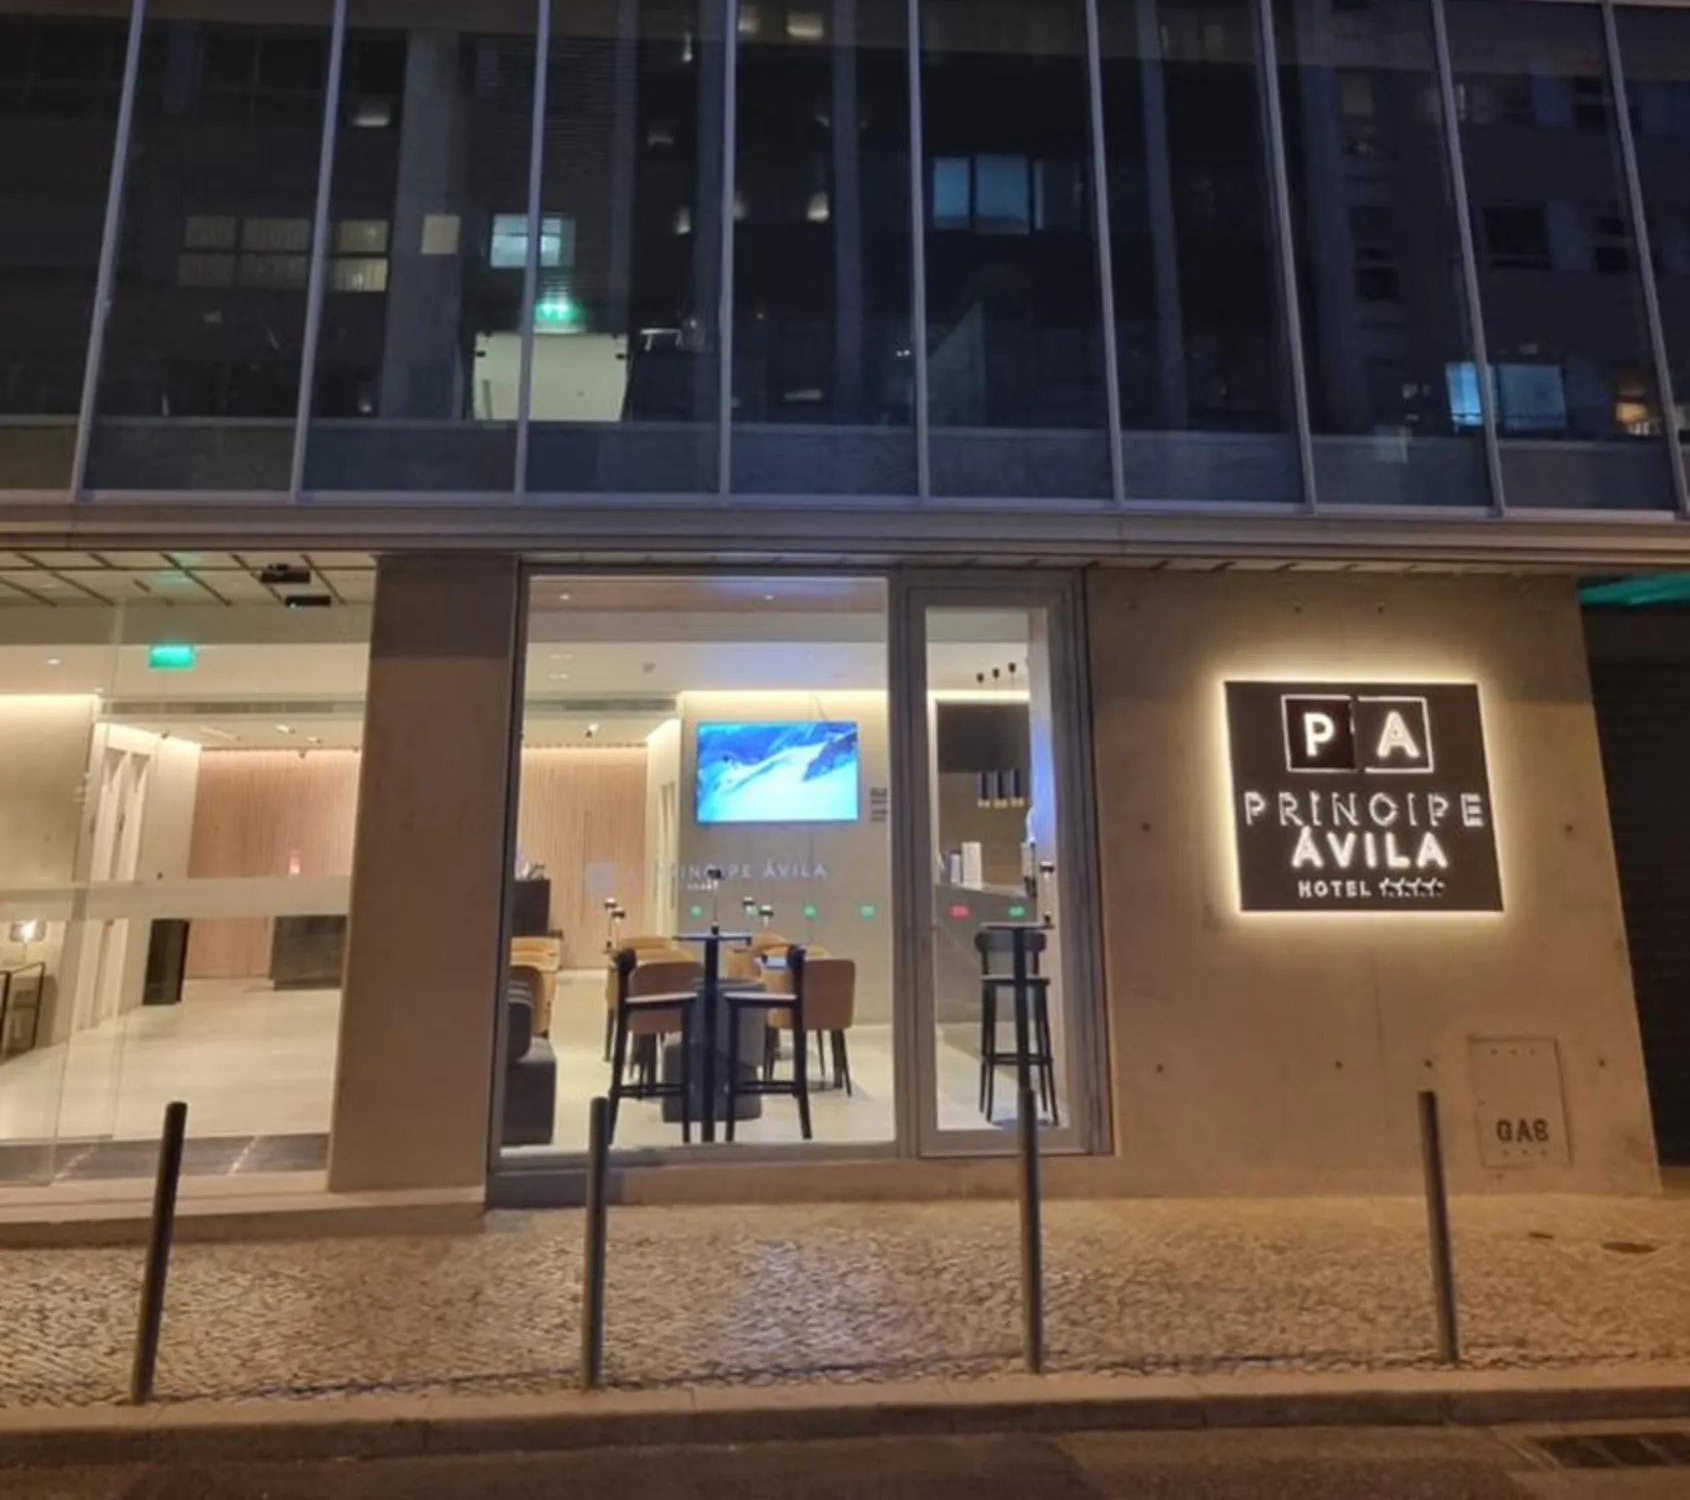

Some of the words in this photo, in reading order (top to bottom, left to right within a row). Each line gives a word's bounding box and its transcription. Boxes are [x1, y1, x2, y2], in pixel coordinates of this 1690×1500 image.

[1291, 825, 1449, 869] ÁVILA
[1298, 880, 1372, 898] HOTEL
[1496, 1118, 1550, 1142] GAS
